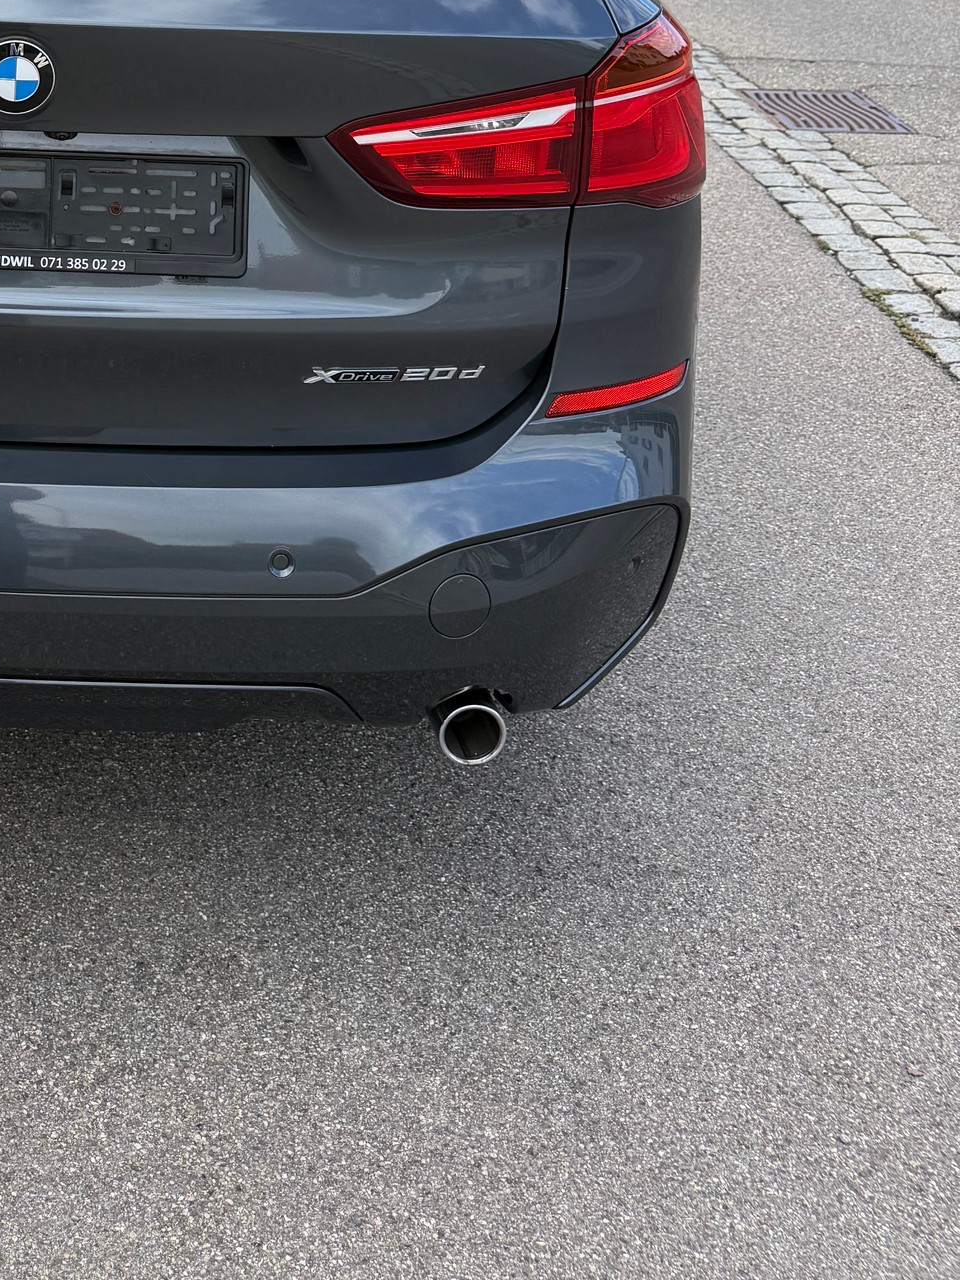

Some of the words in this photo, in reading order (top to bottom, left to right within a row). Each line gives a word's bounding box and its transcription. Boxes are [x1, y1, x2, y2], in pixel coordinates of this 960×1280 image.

[40, 256, 63, 269] 071
[66, 257, 89, 270] 385
[92, 258, 107, 271] 02
[110, 259, 126, 272] 29
